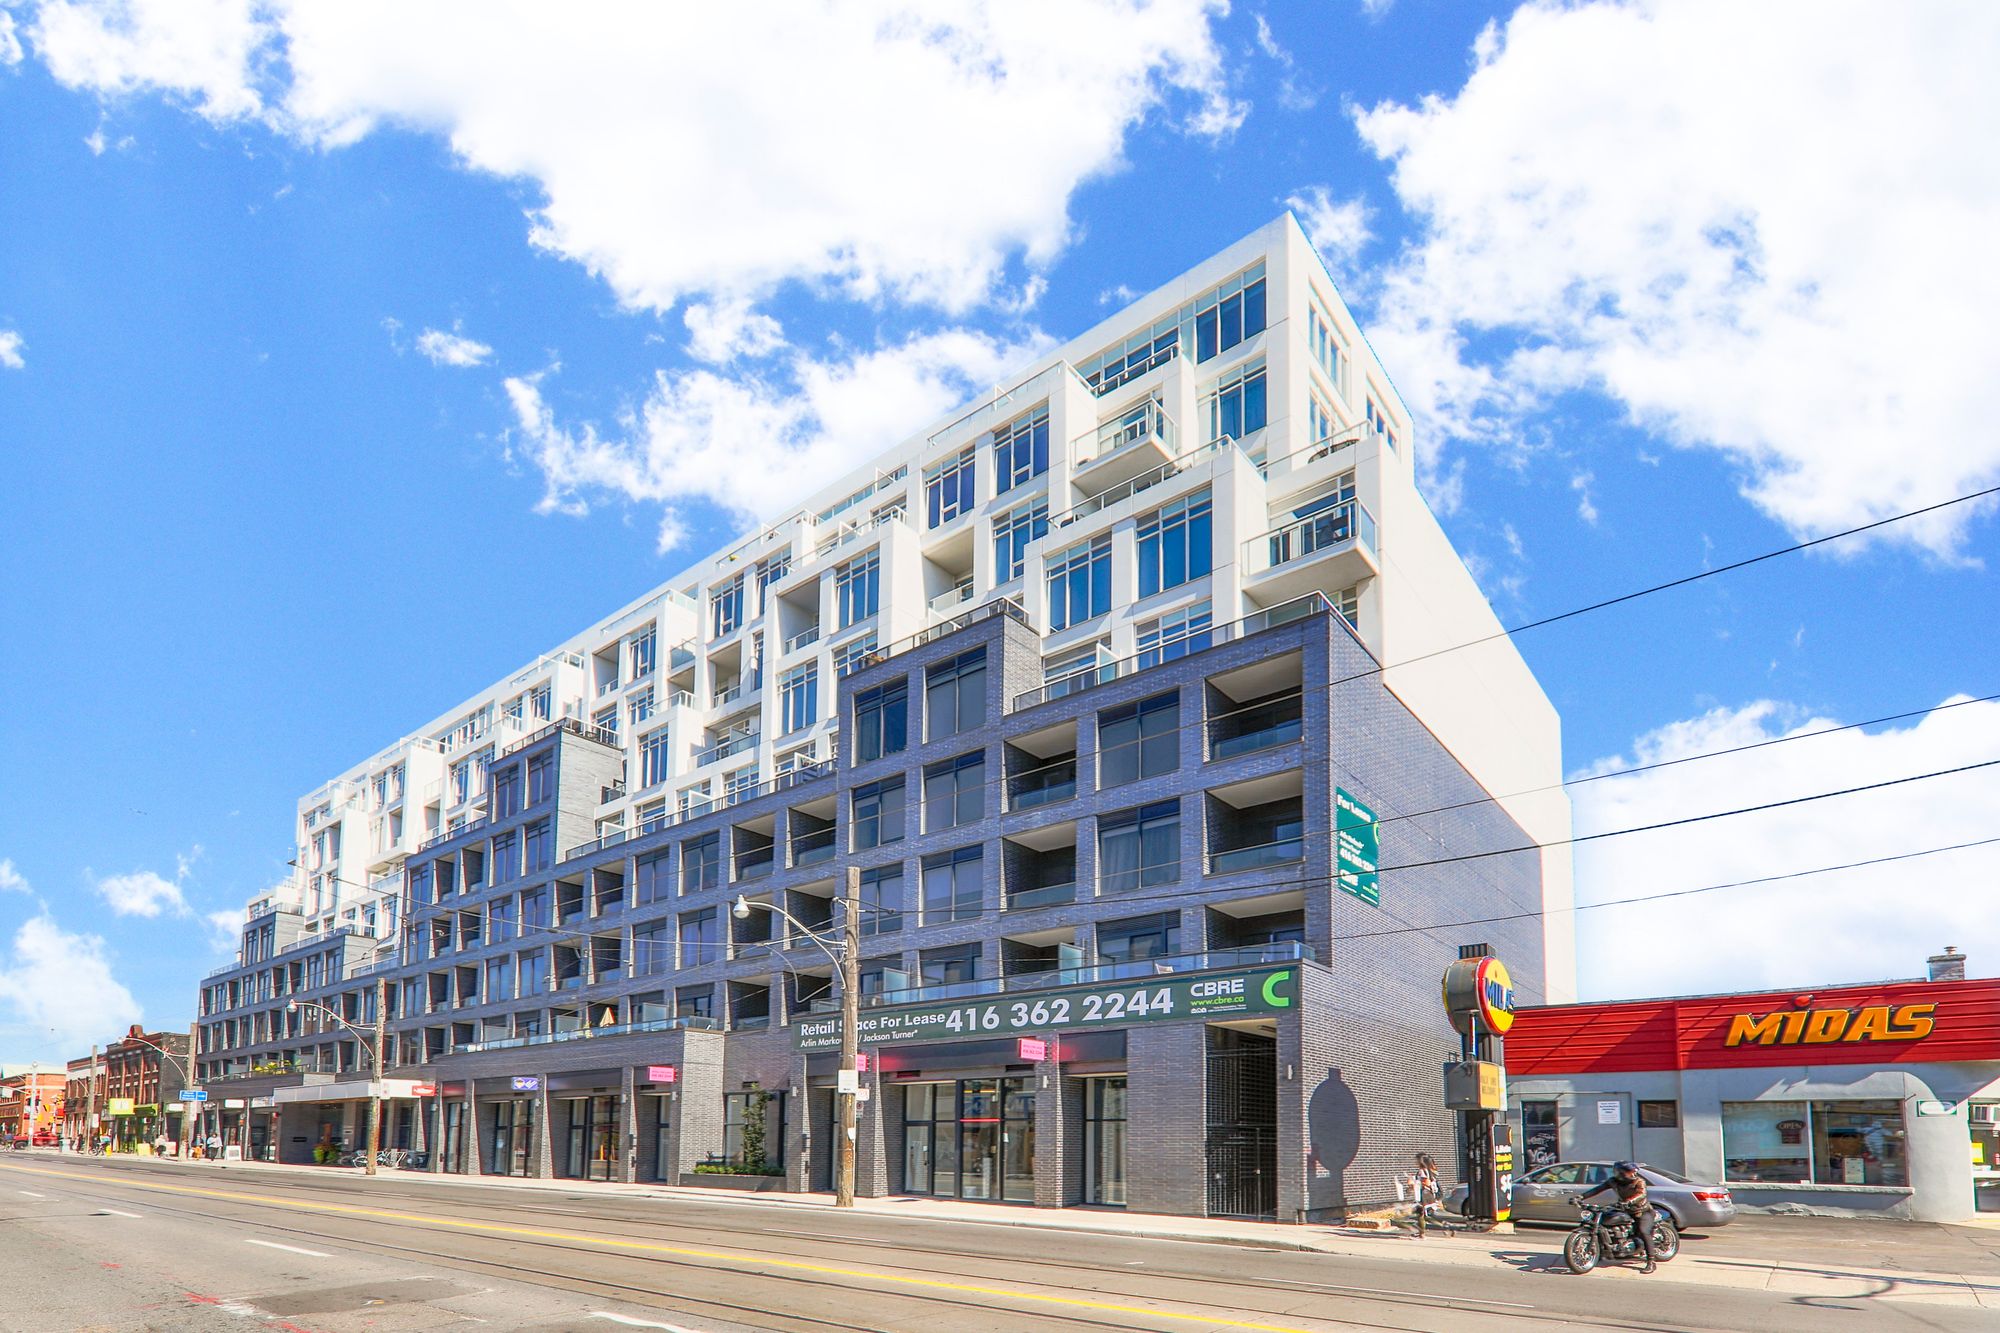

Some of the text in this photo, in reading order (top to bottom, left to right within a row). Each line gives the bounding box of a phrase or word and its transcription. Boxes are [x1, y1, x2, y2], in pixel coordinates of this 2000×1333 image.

[1190, 978, 1244, 997] CBRE
[945, 988, 1174, 1032] 416 362 2244
[1190, 996, 1244, 1006] www.cbre.ca
[801, 1020, 835, 1036] Retail
[881, 1017, 901, 1029] For
[905, 1013, 946, 1026] Lease
[1724, 998, 1936, 1047] MIDAS
[800, 1039, 817, 1048] Arlin
[863, 1031, 890, 1042] Jackson
